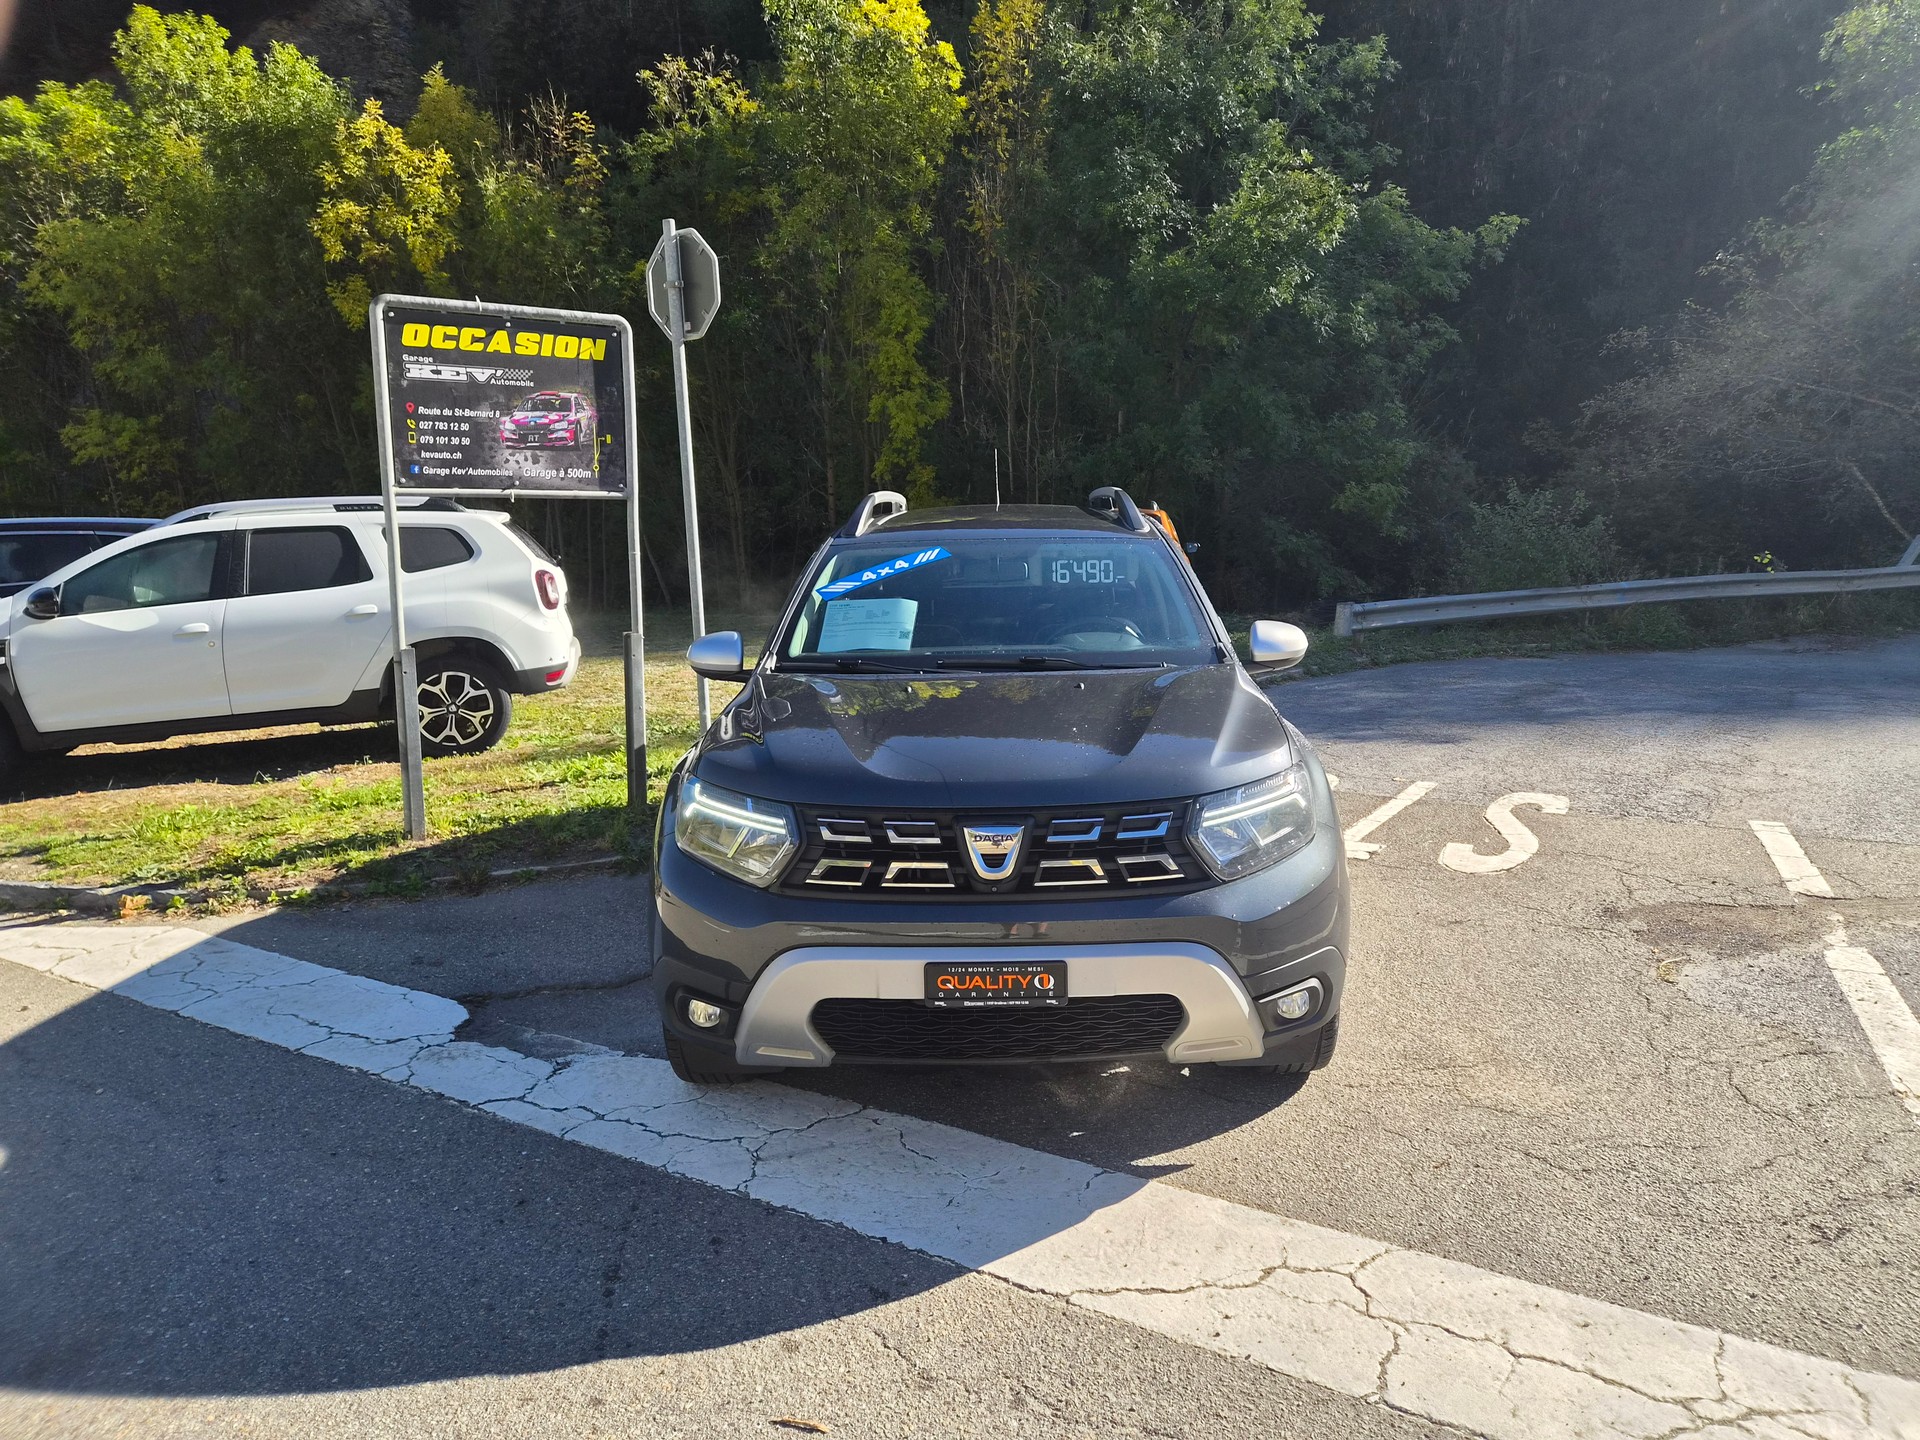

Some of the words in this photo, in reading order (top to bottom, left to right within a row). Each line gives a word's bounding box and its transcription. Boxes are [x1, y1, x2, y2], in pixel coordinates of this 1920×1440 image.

[402, 323, 606, 361] OCCASION
[402, 354, 433, 363] Garage
[490, 378, 534, 387] Automobile
[418, 406, 441, 415] Route
[442, 407, 453, 416] du
[454, 408, 494, 418] St-Bernard
[495, 410, 500, 418] 8
[419, 421, 432, 429] 027
[434, 421, 448, 430] 783
[450, 422, 459, 430] 12
[460, 422, 470, 431] 50
[420, 436, 434, 444] 079
[436, 436, 448, 445] 101
[450, 437, 460, 445] 30
[461, 437, 470, 445] 50
[421, 450, 462, 459] kevauto.ch
[423, 466, 450, 476] Garage
[451, 467, 513, 476] Kev'Automobiles
[523, 468, 557, 479] Garage
[559, 468, 565, 477] à
[567, 469, 592, 478] 500m
[974, 834, 1014, 842] DACIA
[937, 975, 1032, 990] QUALITY
